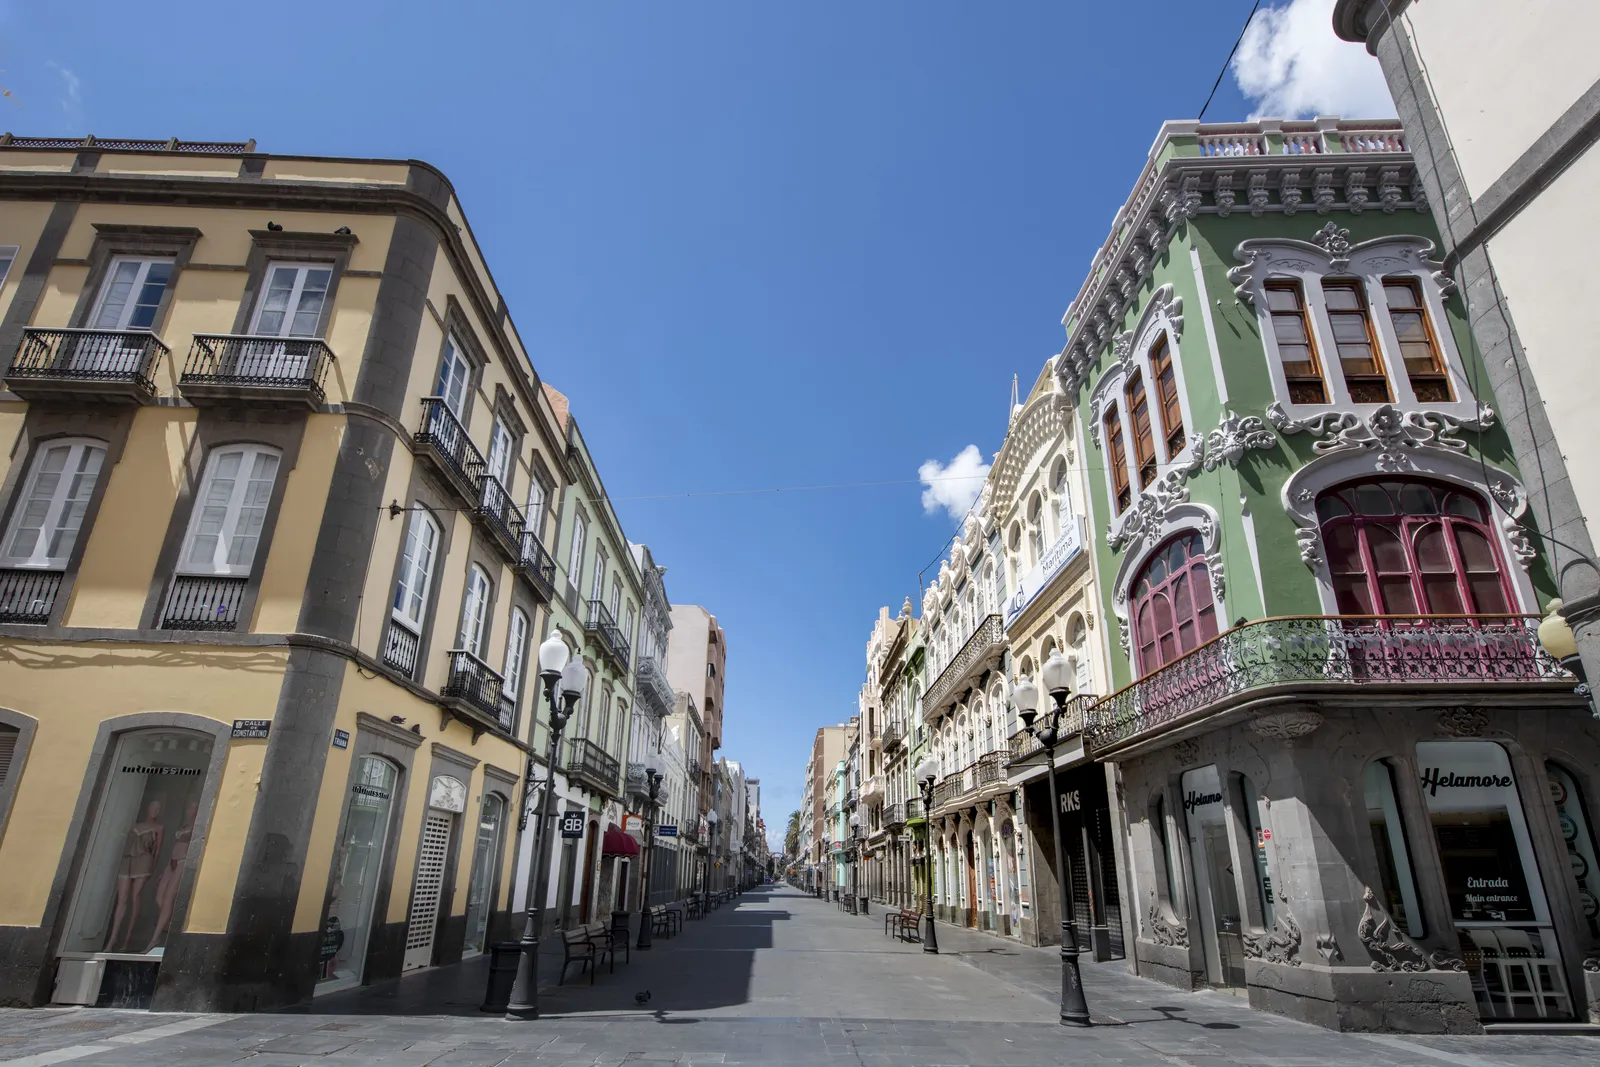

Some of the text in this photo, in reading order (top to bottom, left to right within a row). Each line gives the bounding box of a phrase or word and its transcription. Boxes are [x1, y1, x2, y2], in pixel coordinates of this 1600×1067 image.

[233, 729, 267, 738] CONSTANTINO
[334, 737, 347, 748] TRIANA
[122, 764, 201, 776] intimissimi
[1421, 767, 1513, 797] Helamore
[1060, 789, 1081, 813] RKS
[1184, 791, 1223, 815] Helamo
[1467, 876, 1509, 888] Entrada
[1465, 893, 1518, 903] Main entrance
